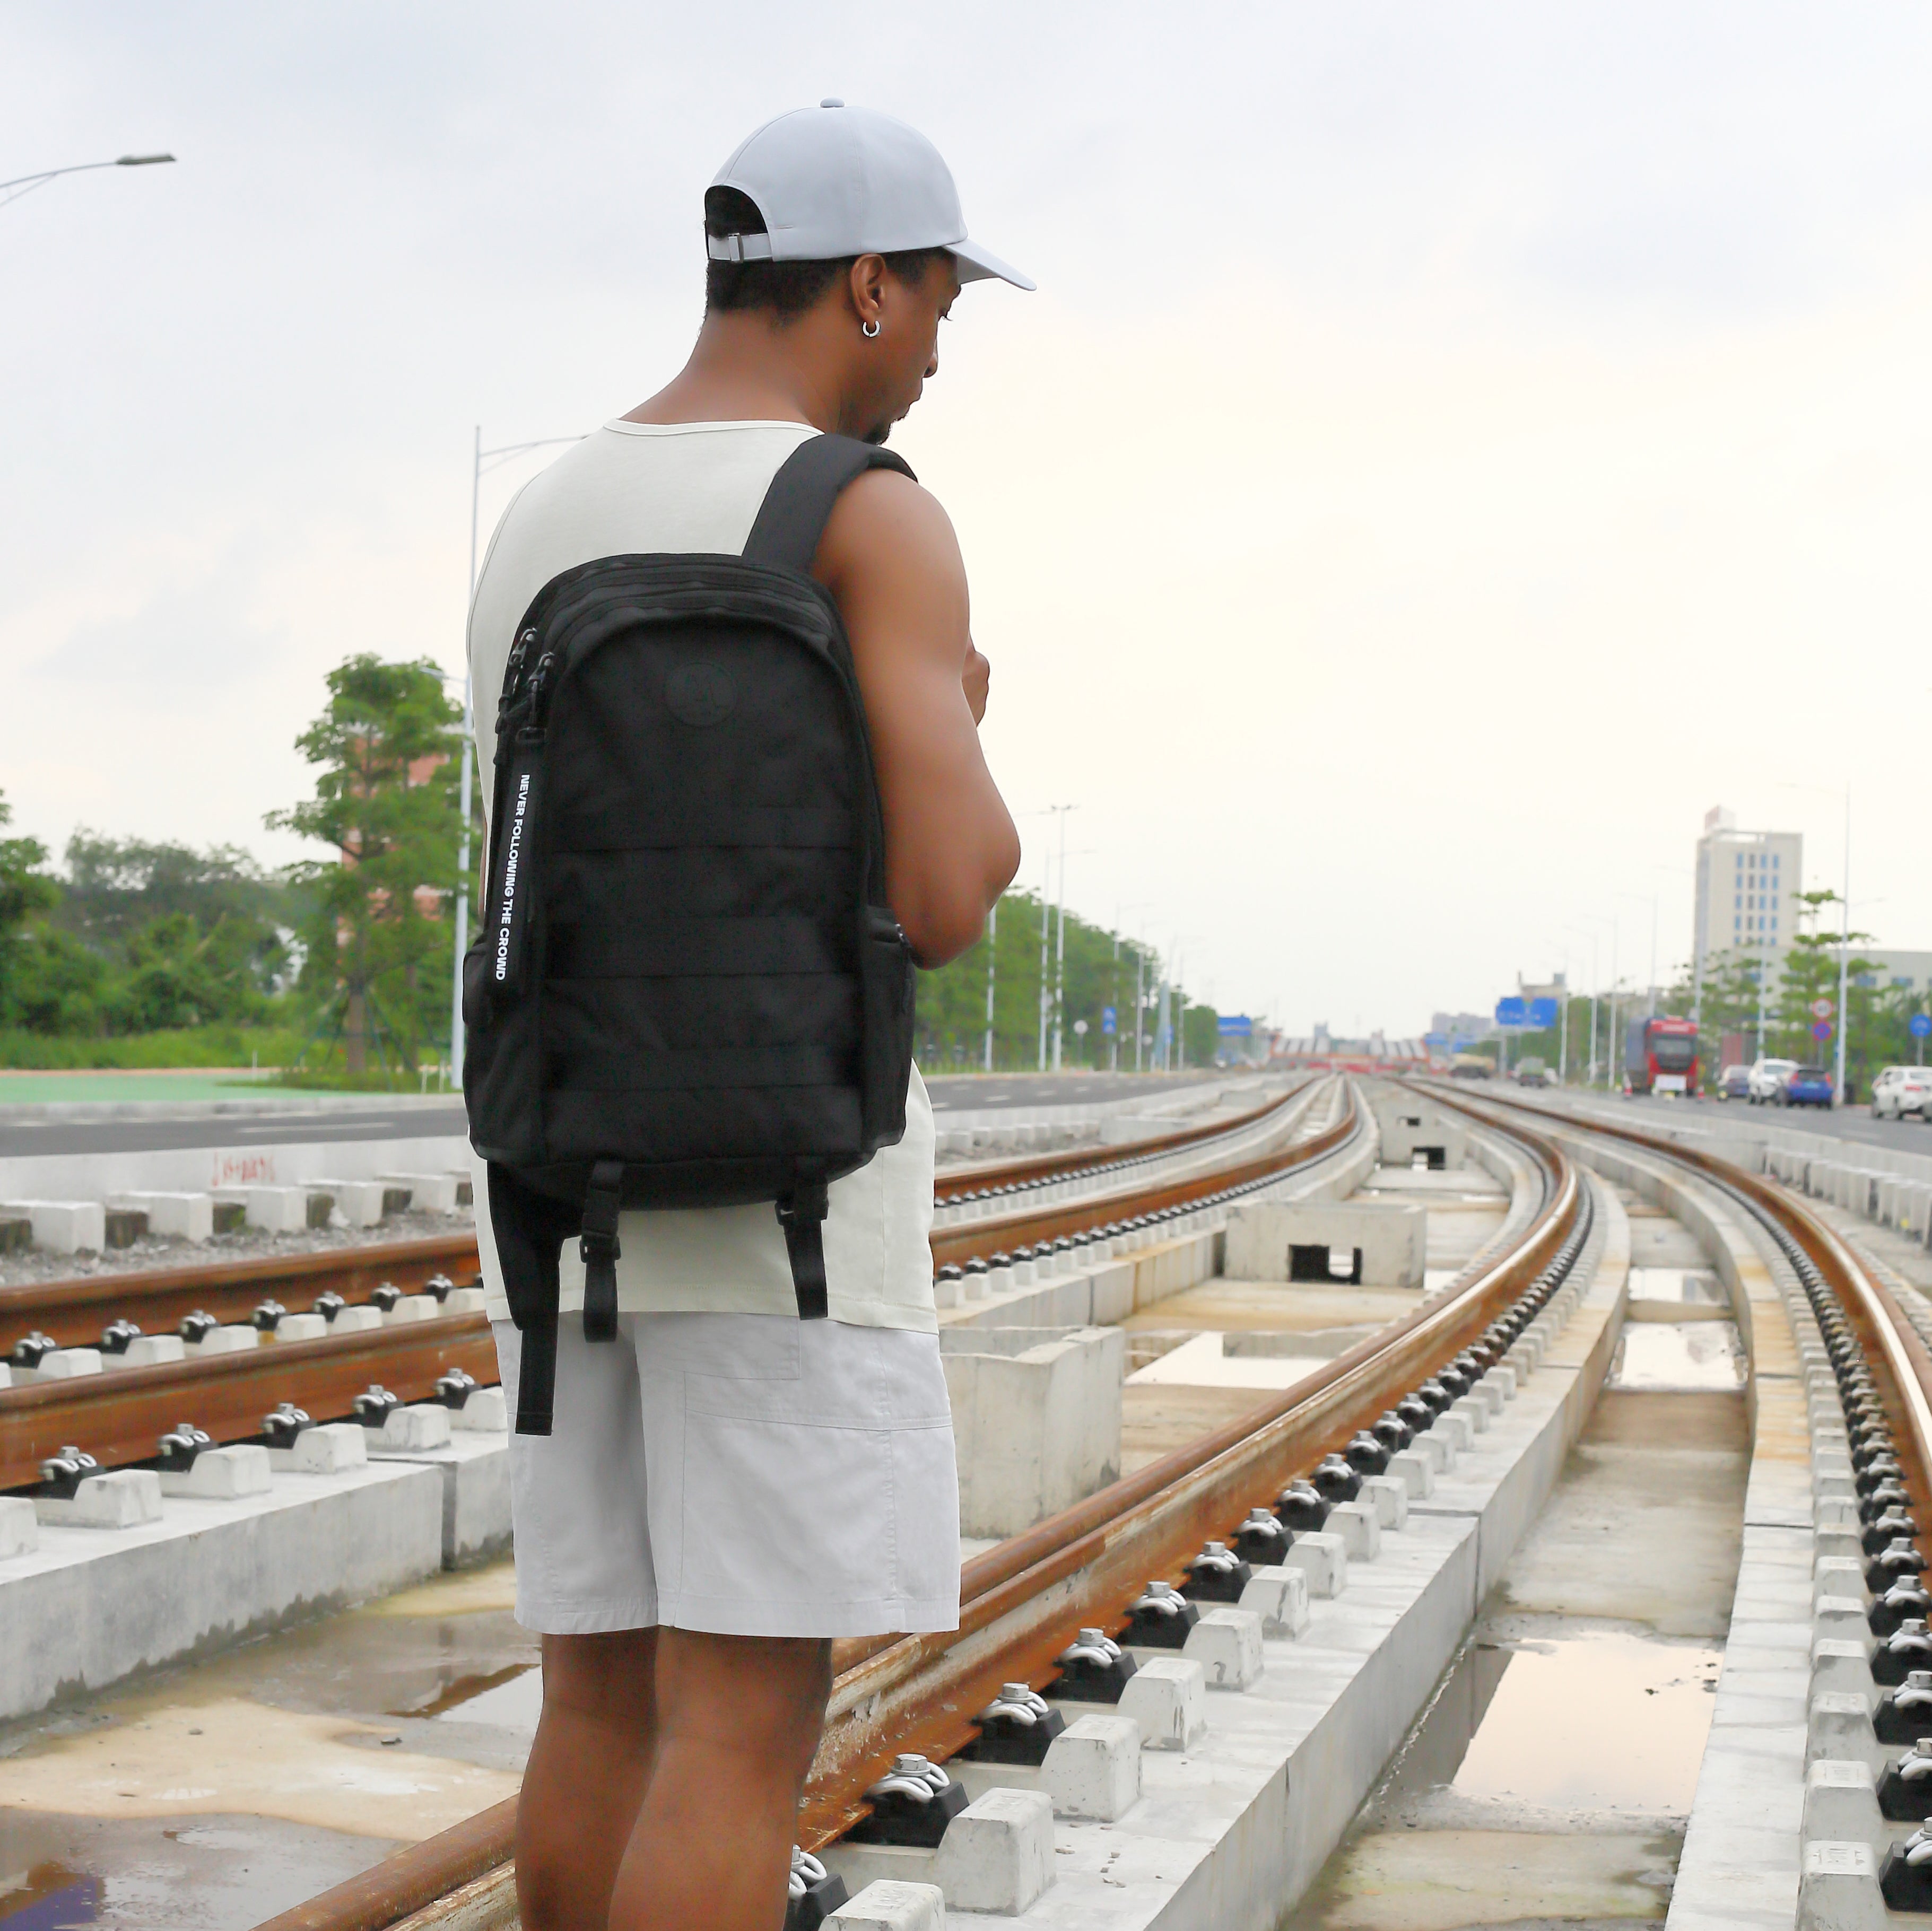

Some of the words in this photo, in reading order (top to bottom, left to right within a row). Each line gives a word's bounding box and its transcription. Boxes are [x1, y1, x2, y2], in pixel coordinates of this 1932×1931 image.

[516, 774, 530, 816] NEVER
[504, 818, 523, 897] FOLLOWING
[501, 898, 514, 924] THE
[495, 928, 510, 981] CROWD
